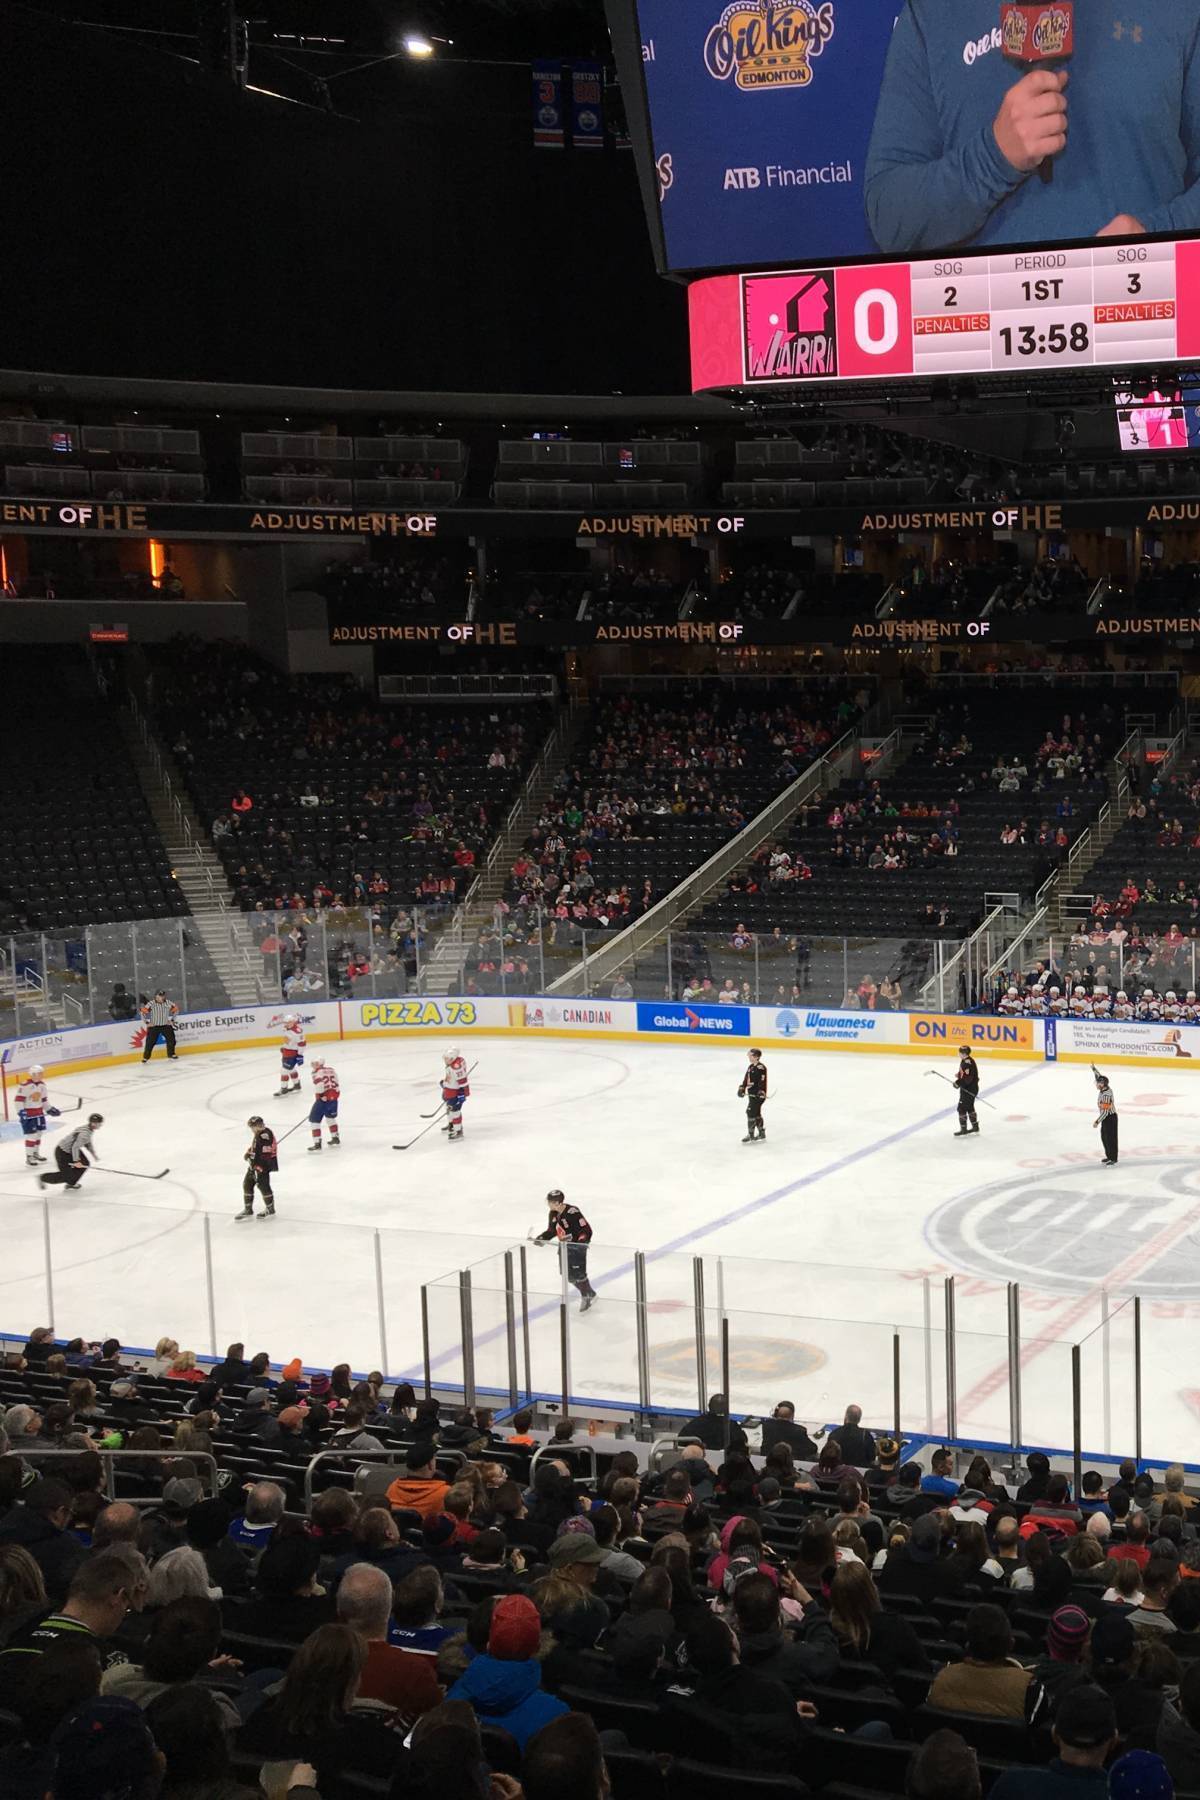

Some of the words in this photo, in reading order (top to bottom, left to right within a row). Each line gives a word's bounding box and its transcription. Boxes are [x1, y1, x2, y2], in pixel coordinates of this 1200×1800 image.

[705, 20, 763, 79] Oil
[764, 5, 834, 58] Kings
[742, 68, 806, 85] EDMONTON
[723, 168, 761, 190] ATB
[766, 161, 852, 188] Financial
[933, 262, 963, 276] SOG
[1014, 254, 1067, 270] PERIOD
[1117, 247, 1148, 262] SOG
[853, 288, 899, 355] 0
[943, 286, 958, 307] 2
[1021, 278, 1064, 302] 1ST
[1127, 273, 1142, 295] 3
[915, 315, 989, 334] PENALTIES
[1096, 304, 1174, 322] PENALTIES
[1000, 322, 1090, 356] 13:58
[1129, 432, 1139, 446] 3
[1159, 423, 1174, 446] 1
[4, 504, 51, 521] ENT
[59, 507, 92, 524] OF
[861, 511, 986, 530] ADJUSTMENT
[992, 510, 1018, 526] OF
[407, 516, 437, 531] OF
[578, 518, 711, 533] ADJUSTMENT
[717, 517, 744, 533] OF
[333, 626, 441, 641] ADJUSTMENT
[447, 626, 474, 640] OF
[596, 625, 713, 640] ADJUSTMENT
[718, 625, 744, 639] OF
[852, 623, 961, 638] ADJUSTMENT
[966, 622, 990, 636] OF
[173, 1018, 212, 1031] Service
[215, 1013, 256, 1027] Experts
[361, 1002, 442, 1026] PIZZA
[445, 1002, 477, 1024] 73
[563, 1009, 612, 1024] CANADIAN
[653, 1016, 689, 1028] Global
[699, 1018, 733, 1030] NEWS
[805, 1012, 876, 1030] Wawanesa
[815, 1029, 859, 1039] Insurance
[915, 1020, 947, 1038] ON
[952, 1026, 967, 1036] the
[972, 1024, 1018, 1042] RUN
[18, 1036, 63, 1050] ACTION
[1075, 1041, 1100, 1049] SPHINX
[322, 1075, 339, 1089] 25
